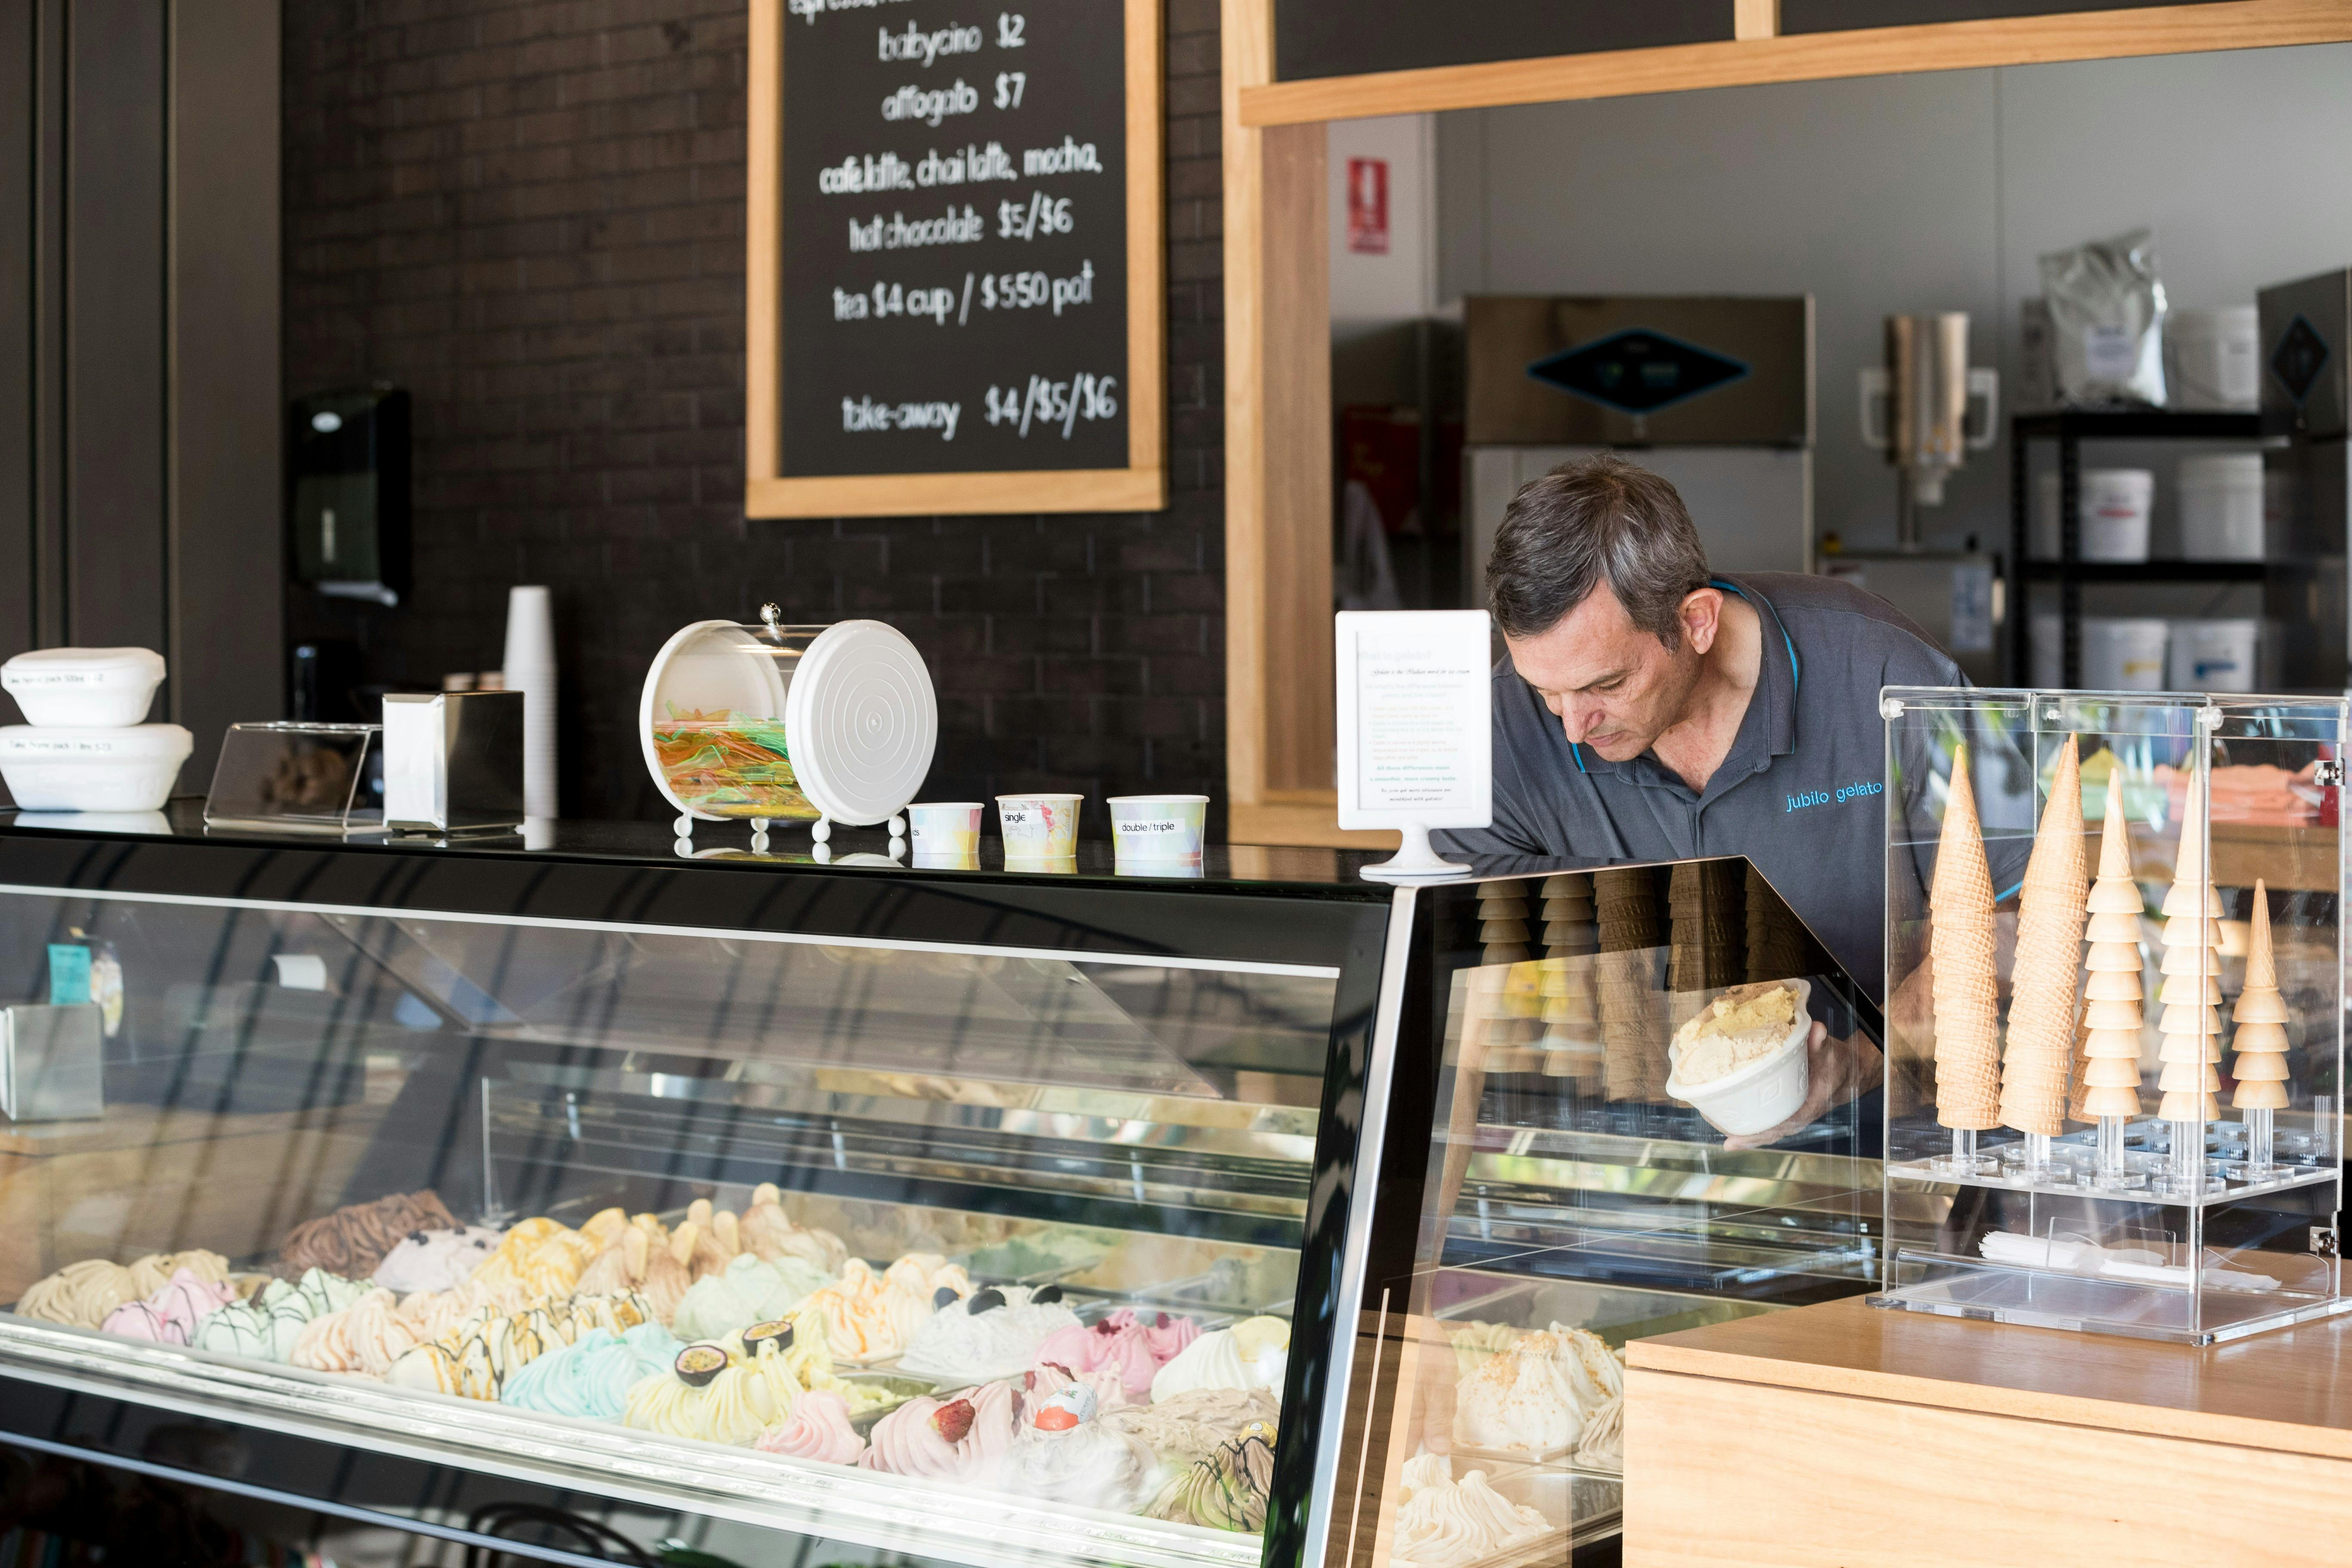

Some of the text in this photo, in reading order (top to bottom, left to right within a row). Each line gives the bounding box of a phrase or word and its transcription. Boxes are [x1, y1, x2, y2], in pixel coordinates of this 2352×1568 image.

[878, 12, 1026, 67] babycino $2
[881, 71, 1026, 127] affogato $7
[916, 148, 966, 187] chai
[1023, 135, 1103, 177] mocha,
[849, 190, 1073, 252] hot chocolate $5/$6
[832, 285, 868, 321] tea
[872, 281, 903, 318] $4
[906, 288, 954, 325] cup
[1052, 259, 1094, 316] pot
[841, 372, 1117, 441] take-away $4/$5/$6
[1004, 812, 1026, 823] single
[1786, 781, 1883, 812] jubilo gelato
[1122, 823, 1147, 831] double
[1153, 822, 1175, 832] triple
